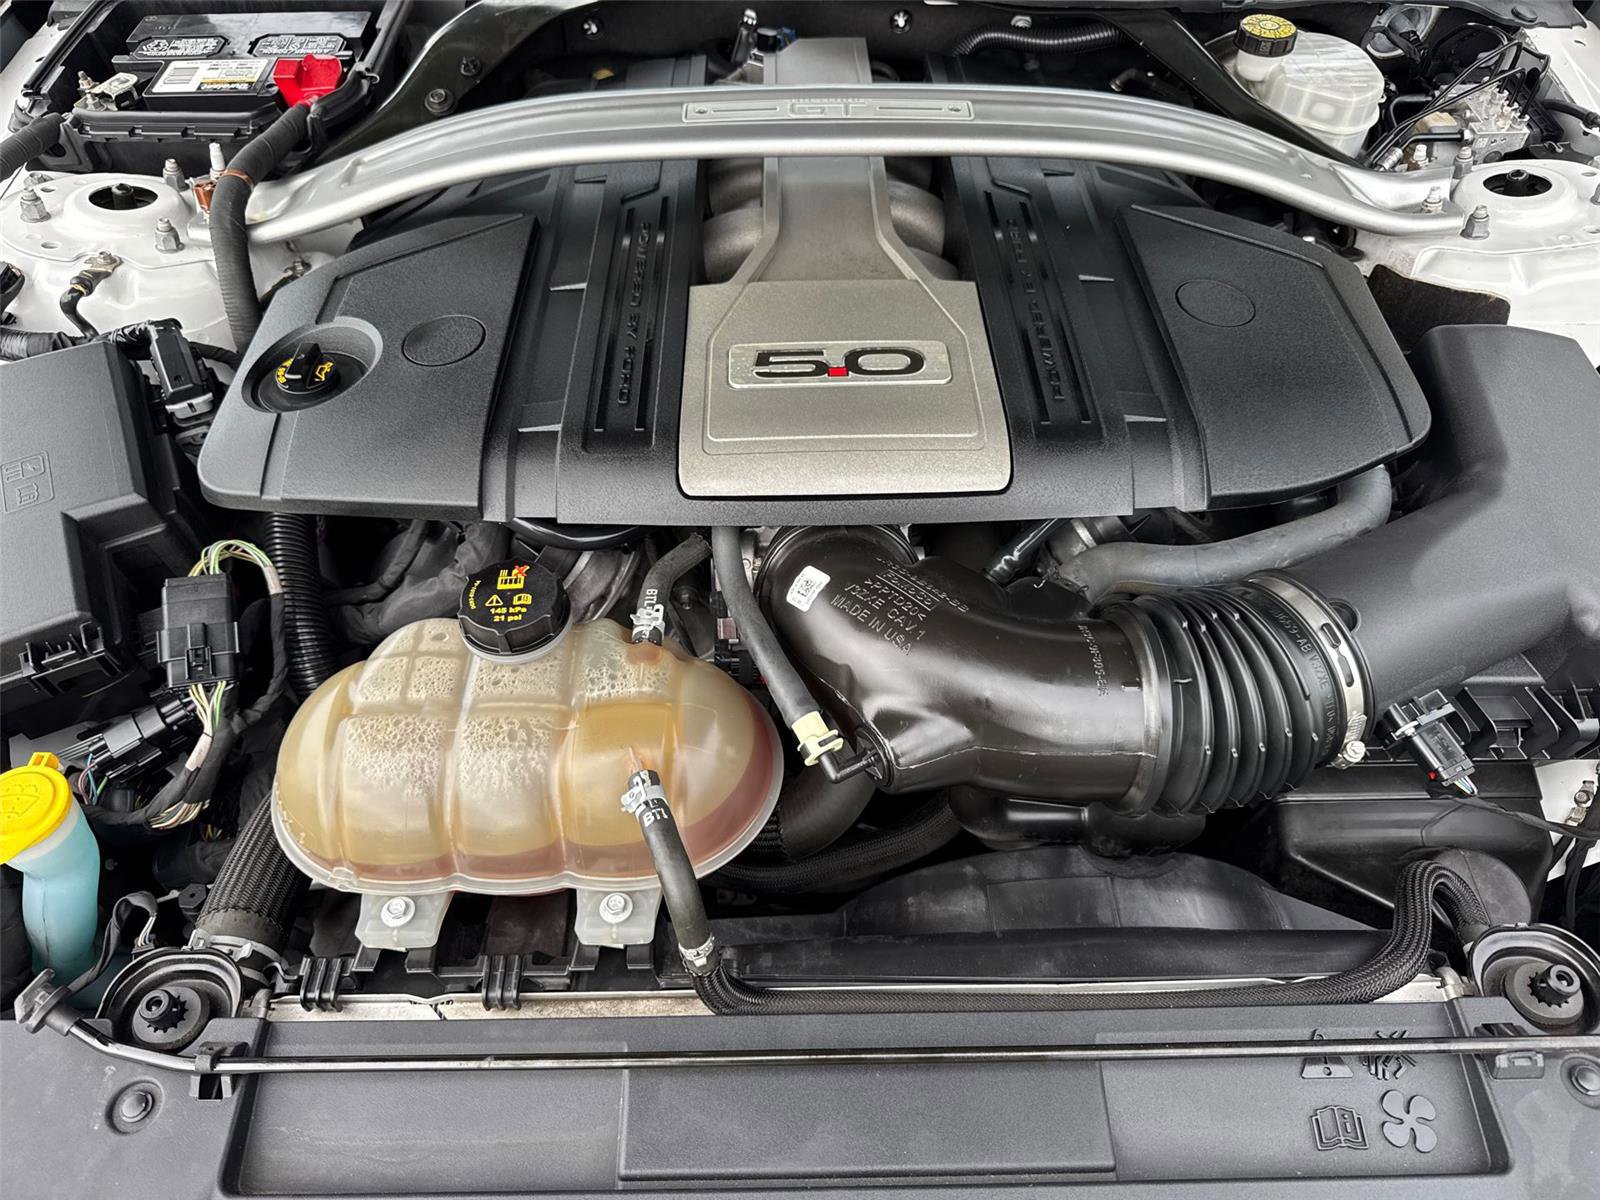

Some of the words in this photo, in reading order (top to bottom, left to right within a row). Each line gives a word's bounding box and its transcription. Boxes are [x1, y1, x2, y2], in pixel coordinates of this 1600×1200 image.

[789, 102, 867, 118] GT
[752, 347, 926, 378] 5.0
[507, 614, 522, 622] psi
[831, 593, 869, 622] MADE
[867, 616, 885, 634] IN
[883, 627, 912, 656] USA
